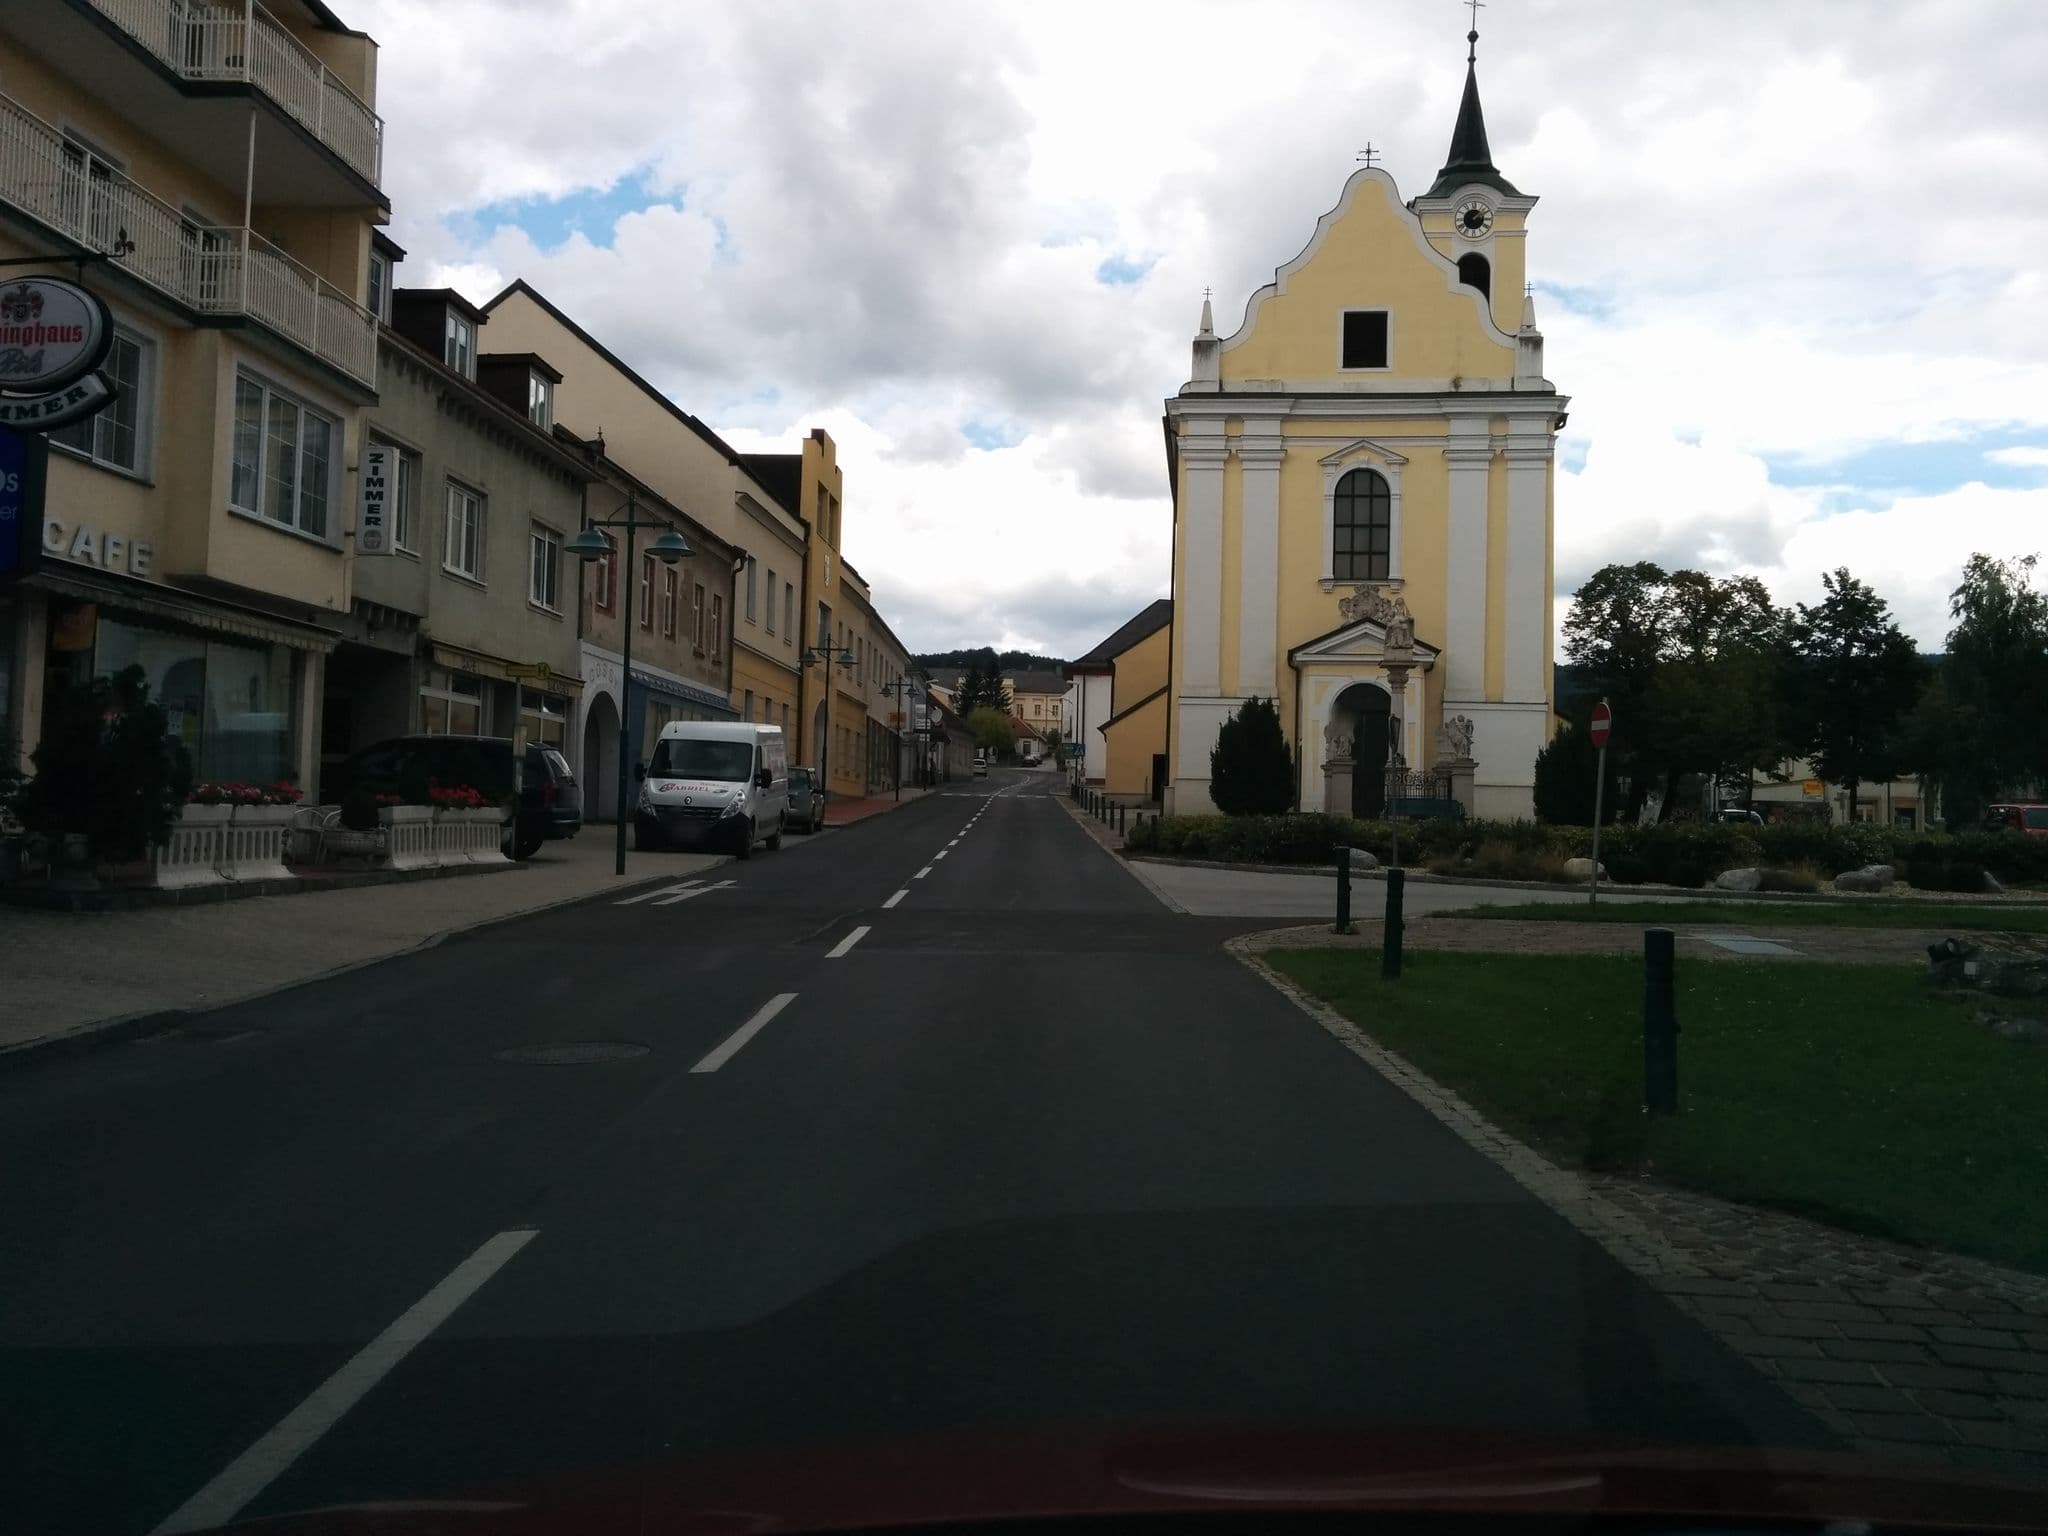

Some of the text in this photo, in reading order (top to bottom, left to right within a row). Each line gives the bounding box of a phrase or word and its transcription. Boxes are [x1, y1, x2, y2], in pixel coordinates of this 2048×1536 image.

[0, 322, 83, 347] inghaus
[365, 453, 384, 526] ZIMMER
[42, 516, 152, 576] CAFE
